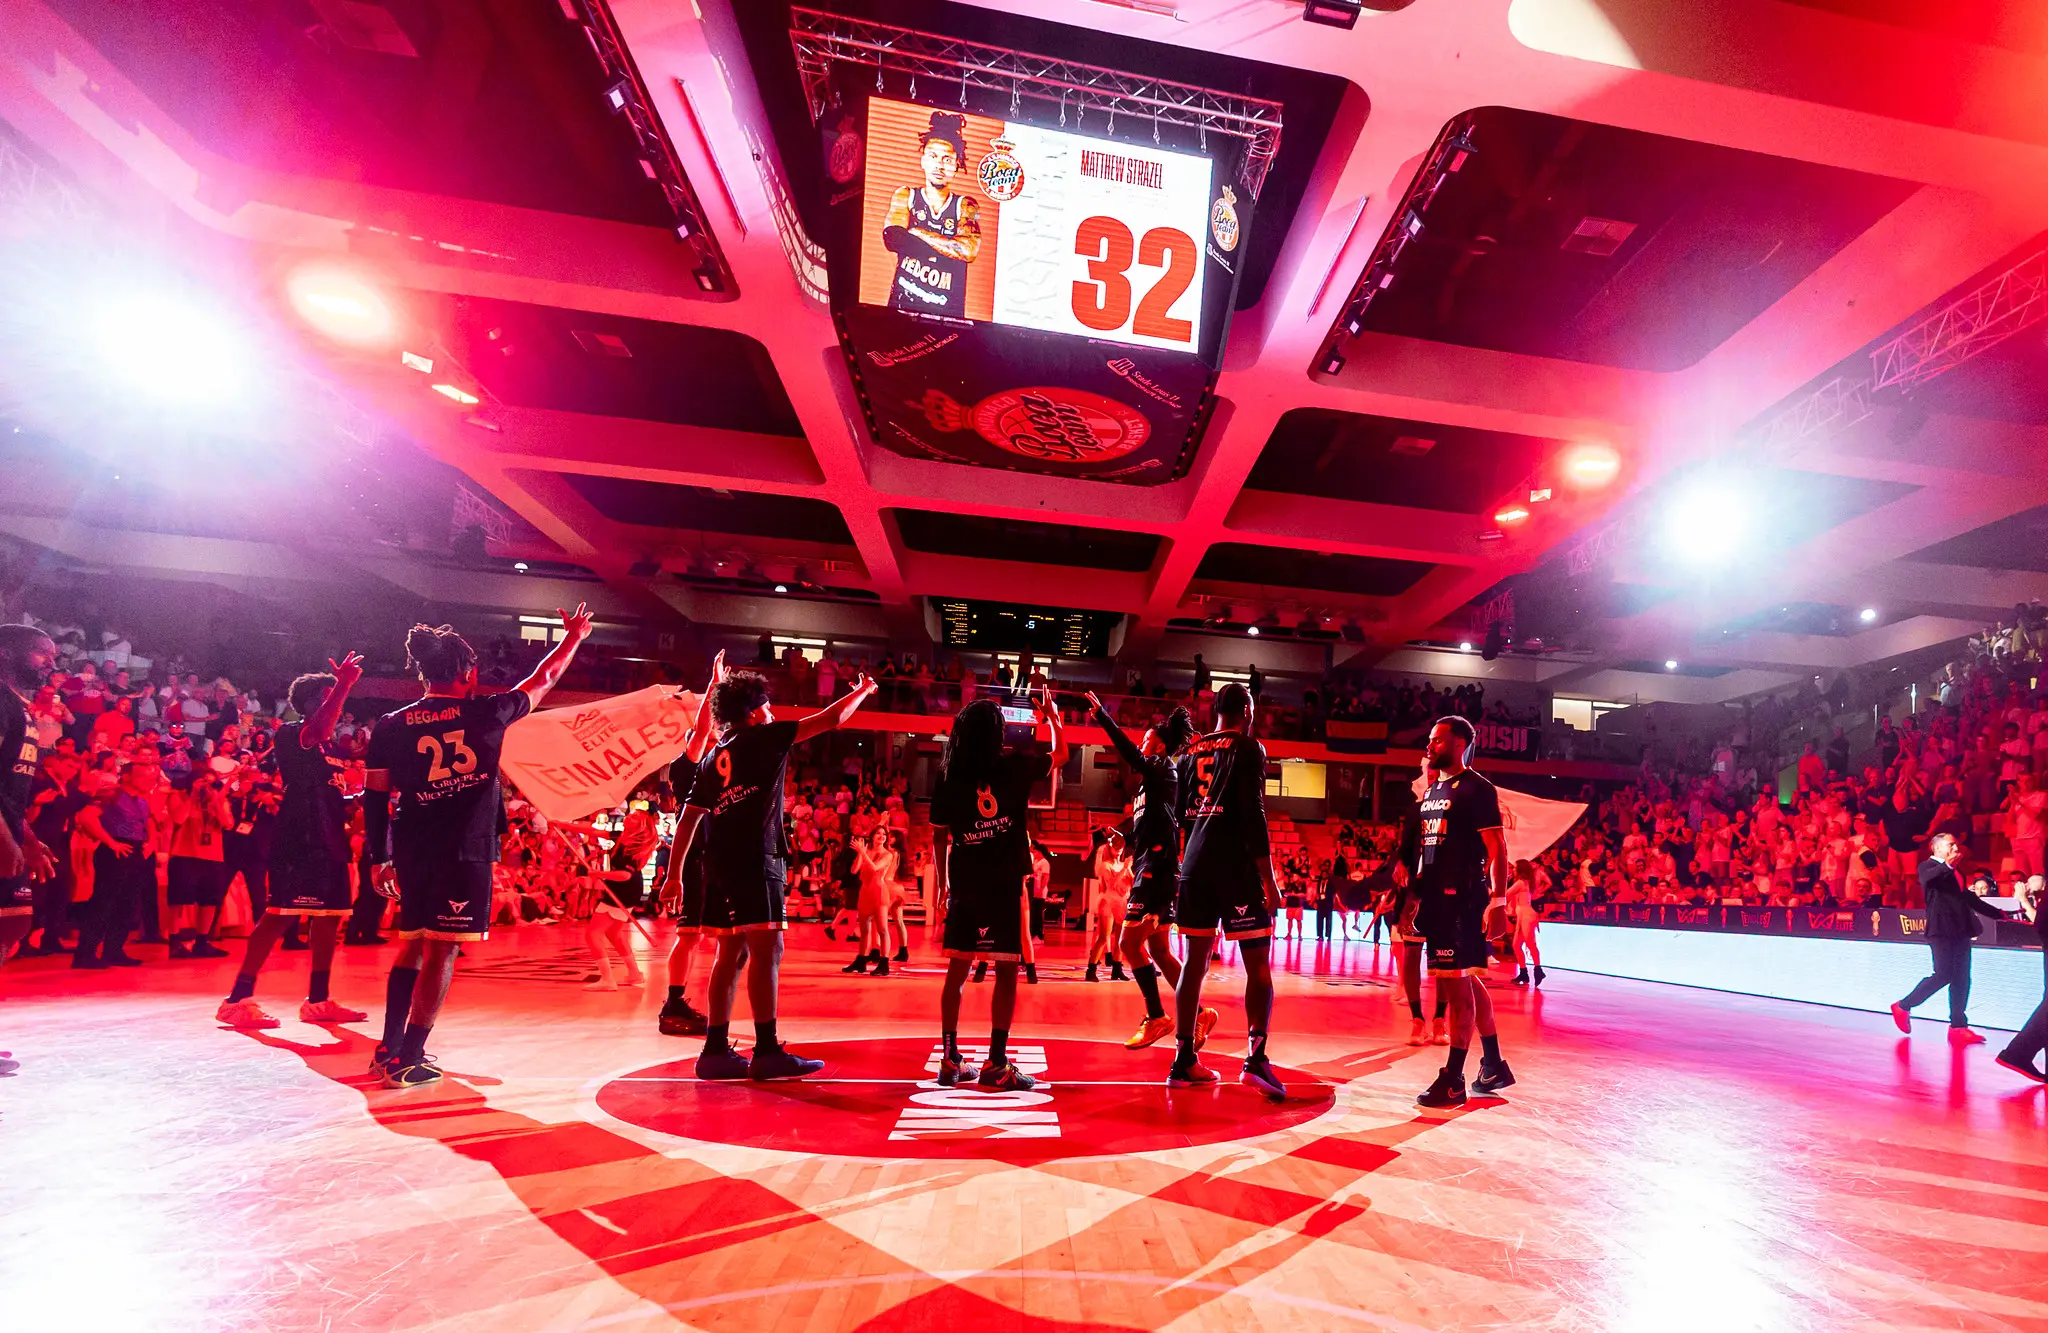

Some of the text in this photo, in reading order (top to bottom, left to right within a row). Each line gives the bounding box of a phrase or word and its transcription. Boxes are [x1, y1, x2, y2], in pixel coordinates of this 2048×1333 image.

[979, 160, 1020, 180] Roca
[1080, 149, 1164, 190] MATTHEW STRAZEL
[1071, 214, 1198, 343] 32
[1132, 370, 1153, 386] Stade
[1150, 383, 1171, 398] Louis
[1010, 393, 1086, 459] Roca
[1116, 418, 1146, 451] BASKET
[405, 706, 461, 726] BEGARIN
[539, 711, 683, 791] FINALES
[581, 723, 618, 753] ELITE
[417, 729, 478, 782] 23
[716, 749, 732, 789] 9
[432, 773, 475, 790] GROUPE
[1197, 756, 1215, 797] 5
[963, 829, 996, 843] MICHEL
[974, 816, 1010, 830] GROUPE
